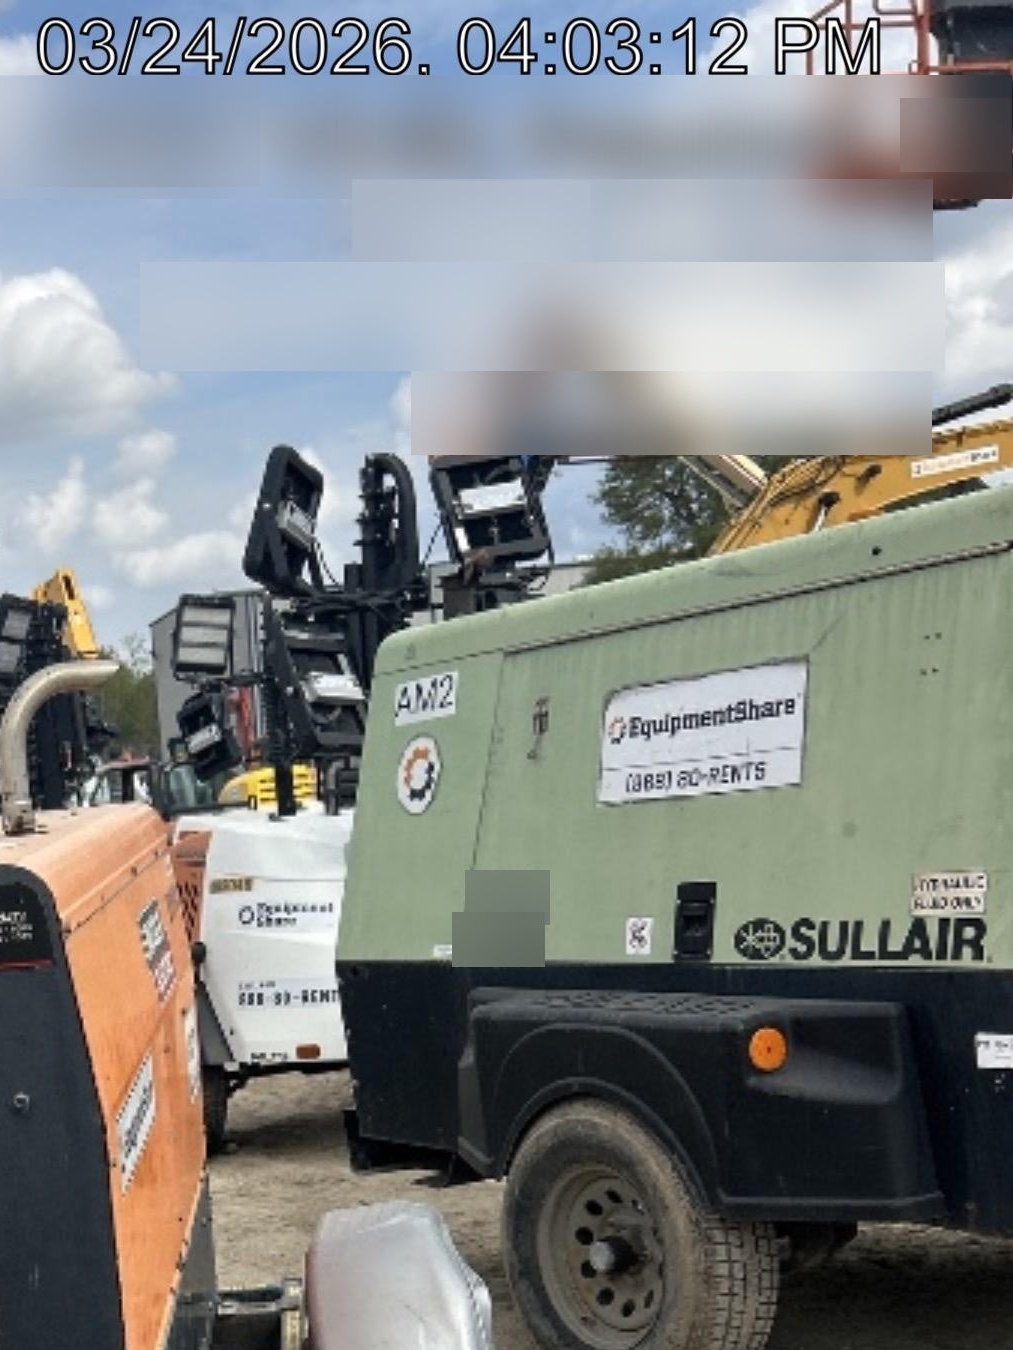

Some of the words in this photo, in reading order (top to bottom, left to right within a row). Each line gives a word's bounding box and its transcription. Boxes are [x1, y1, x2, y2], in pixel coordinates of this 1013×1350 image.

[394, 674, 453, 718] AM2
[629, 698, 796, 741] EquipmentShare
[788, 917, 987, 961] SULLAIR
